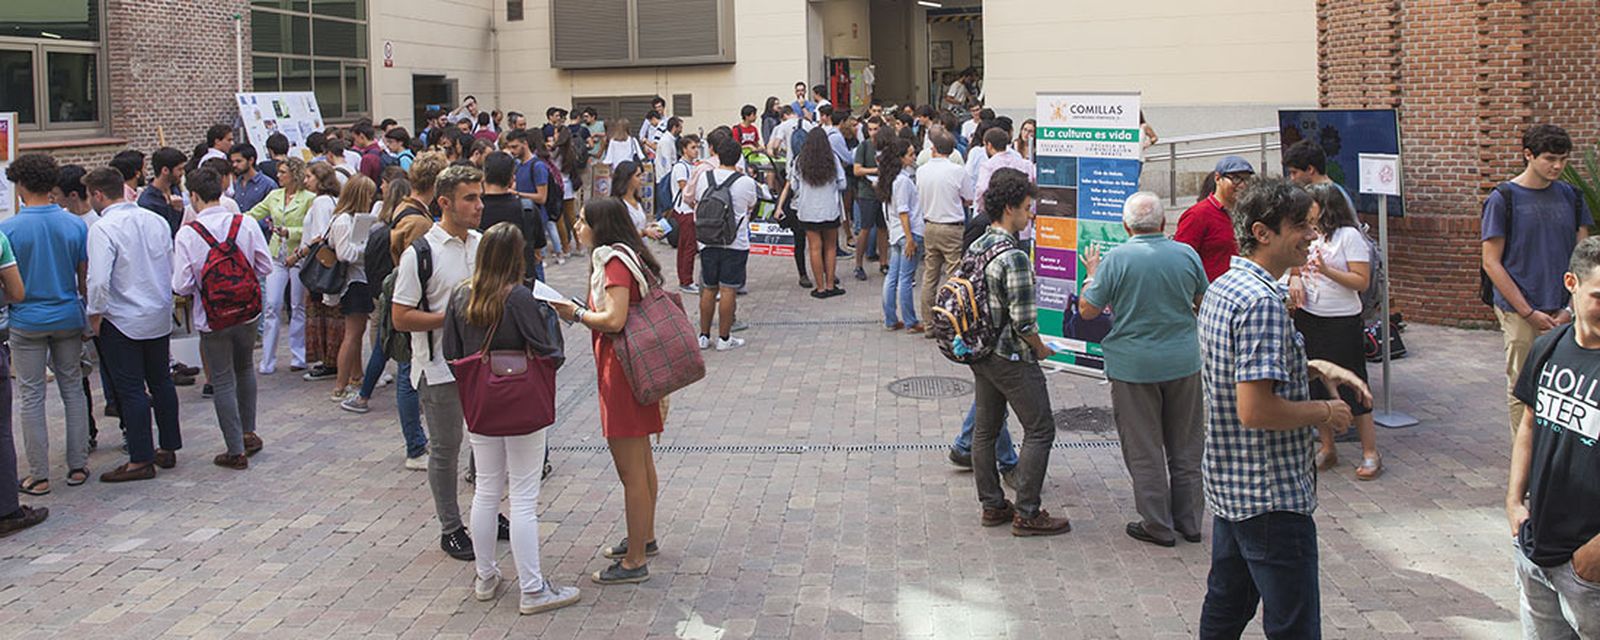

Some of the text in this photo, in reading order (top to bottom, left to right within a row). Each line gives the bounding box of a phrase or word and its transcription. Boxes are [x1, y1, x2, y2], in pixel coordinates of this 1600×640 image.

[1070, 104, 1123, 115] COMILLAS
[1043, 128, 1055, 138] La
[1057, 129, 1092, 139] cultura
[1108, 130, 1132, 140] vida
[1539, 361, 1599, 407] HOLL
[1535, 389, 1586, 431] STER
